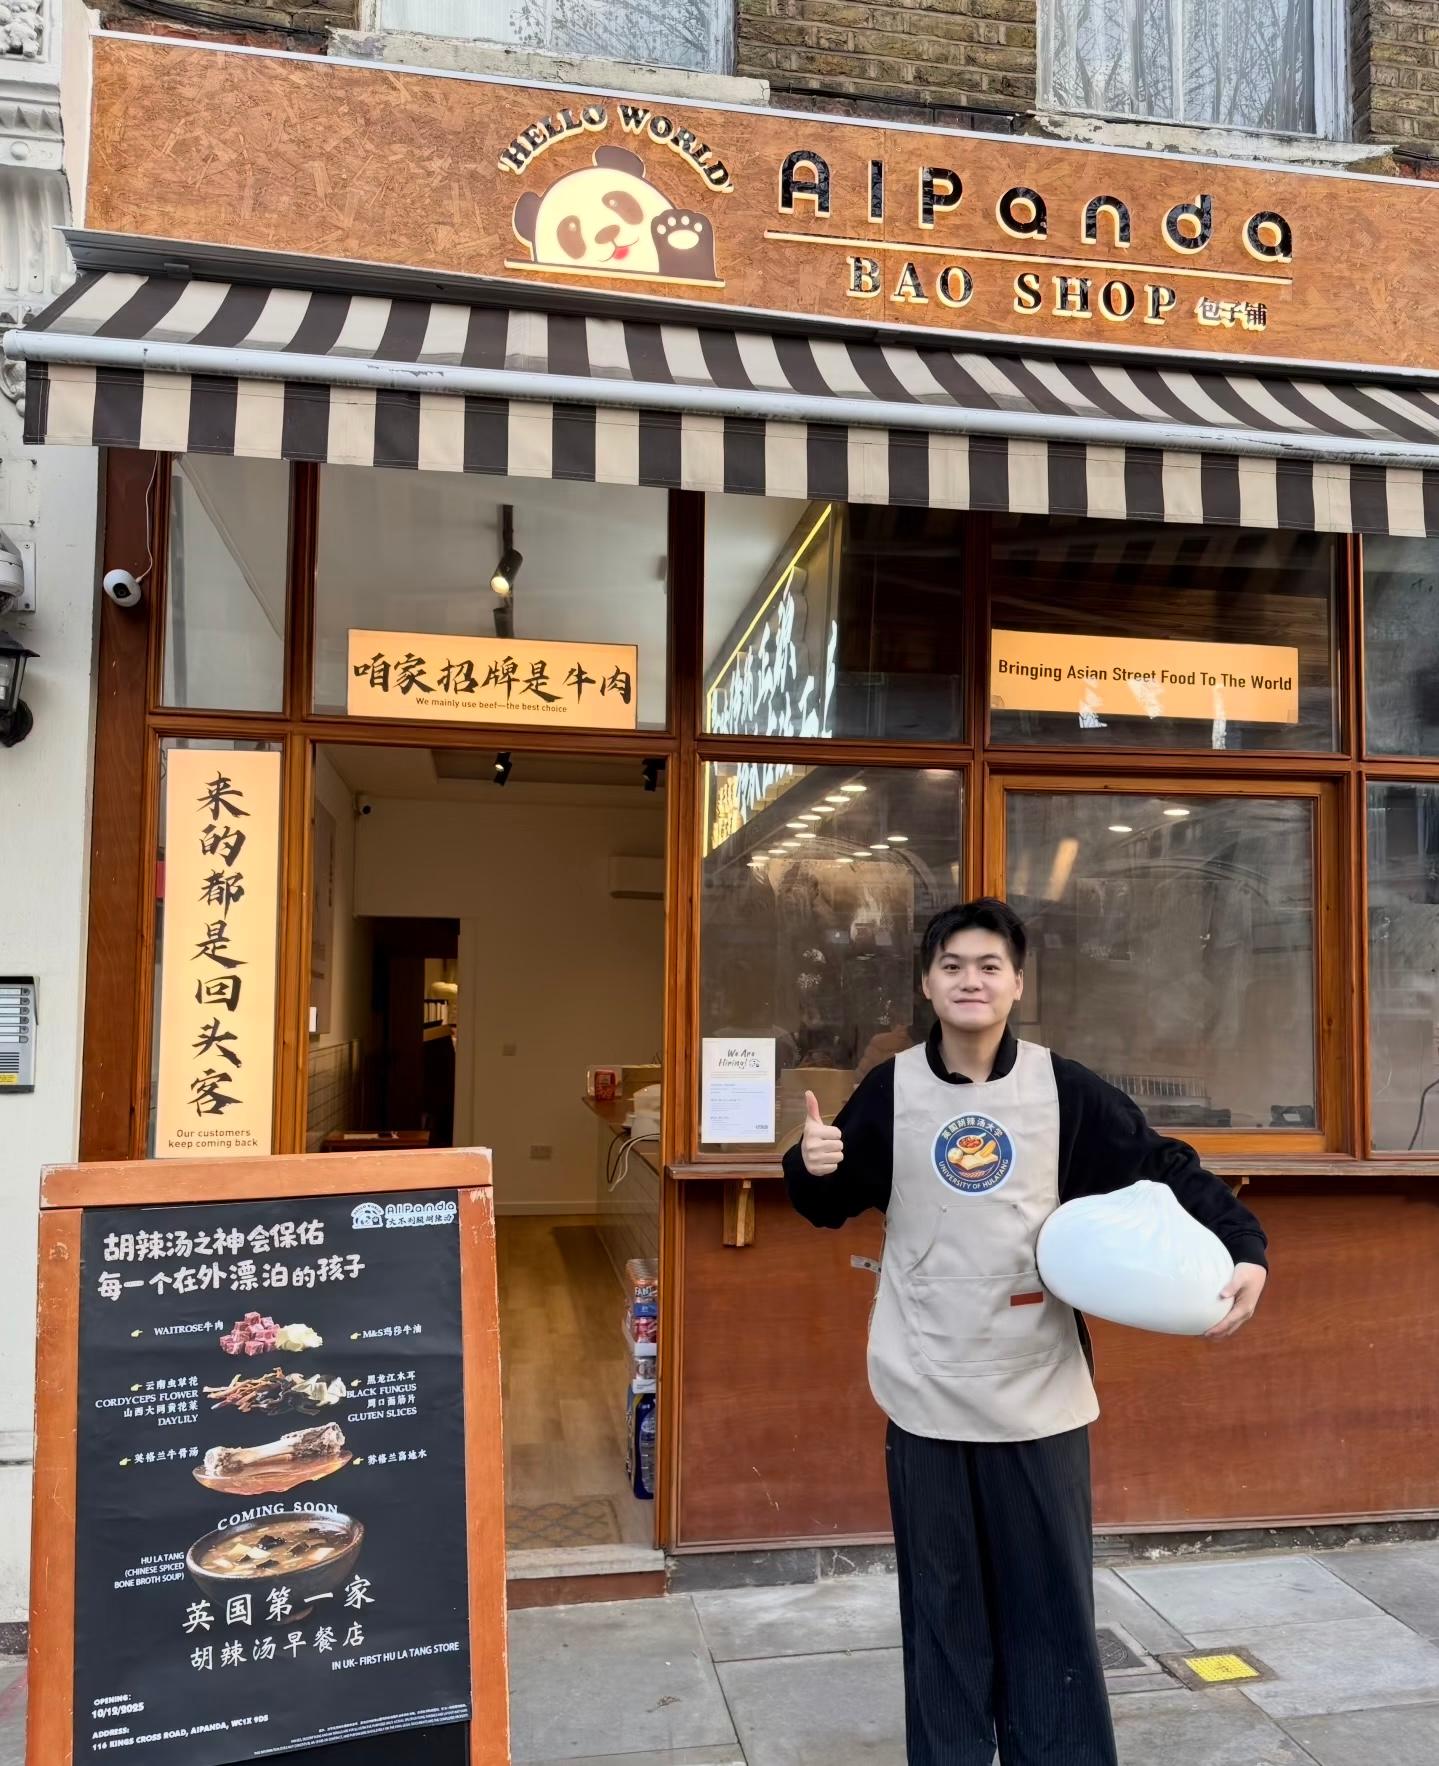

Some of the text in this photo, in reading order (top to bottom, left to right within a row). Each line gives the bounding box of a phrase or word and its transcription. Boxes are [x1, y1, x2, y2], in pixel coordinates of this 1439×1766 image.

[498, 104, 734, 193] HELLO WORLD
[846, 256, 1177, 325] BAO SHOP
[1194, 295, 1267, 331] 包子铺
[353, 652, 631, 704] 咱家招牌是牛肉
[998, 659, 1292, 691] Bringing Asian Street Food To The World
[416, 697, 430, 705] We
[431, 698, 459, 708] mainly
[542, 704, 568, 713] choice
[187, 770, 251, 1118] 来的都是回头客
[728, 1049, 755, 1057] We Are
[176, 1128, 251, 1138] Our customers
[168, 1138, 258, 1150] keep coming back
[938, 1160, 972, 1189] UNIVERSITY
[982, 1159, 1008, 1188] HULATANG
[103, 1219, 325, 1262] 胡辣汤之神会保佑
[98, 1254, 366, 1301] 每一个在外漂泊的孩子
[146, 1376, 198, 1391] 云南虫草花
[367, 1370, 416, 1386] 黑龙江木耳
[95, 1390, 198, 1408] CORDYCEPS FLOWER
[346, 1384, 417, 1399] BLACK FUNGUS
[124, 1400, 198, 1418] 山西大同黄花菜
[348, 1407, 417, 1422] GLUTEN SLICES
[158, 1414, 198, 1426] DAYLILY
[218, 1502, 338, 1530] COMING SOON
[141, 1552, 184, 1564] HU LA TANG
[125, 1562, 184, 1578] (CHINESE SPICED
[114, 1572, 184, 1589] BONE BROTH SOUP)
[182, 1574, 376, 1634] 英国第一家
[190, 1621, 366, 1671] 胡辣汤早餐店
[332, 1642, 460, 1670] IN UK- FIRST HU LA TANG STORE
[94, 1694, 132, 1706] OPENING:
[92, 1702, 144, 1719] 10/12/2025
[92, 1727, 130, 1740] ADDRESS:
[92, 1742, 108, 1751] 116
[110, 1737, 134, 1748] KINGS
[136, 1733, 162, 1744] CROSS
[163, 1728, 189, 1740] ROAD,
[190, 1722, 229, 1735] AIPANDA,
[230, 1718, 252, 1728] WC1X
